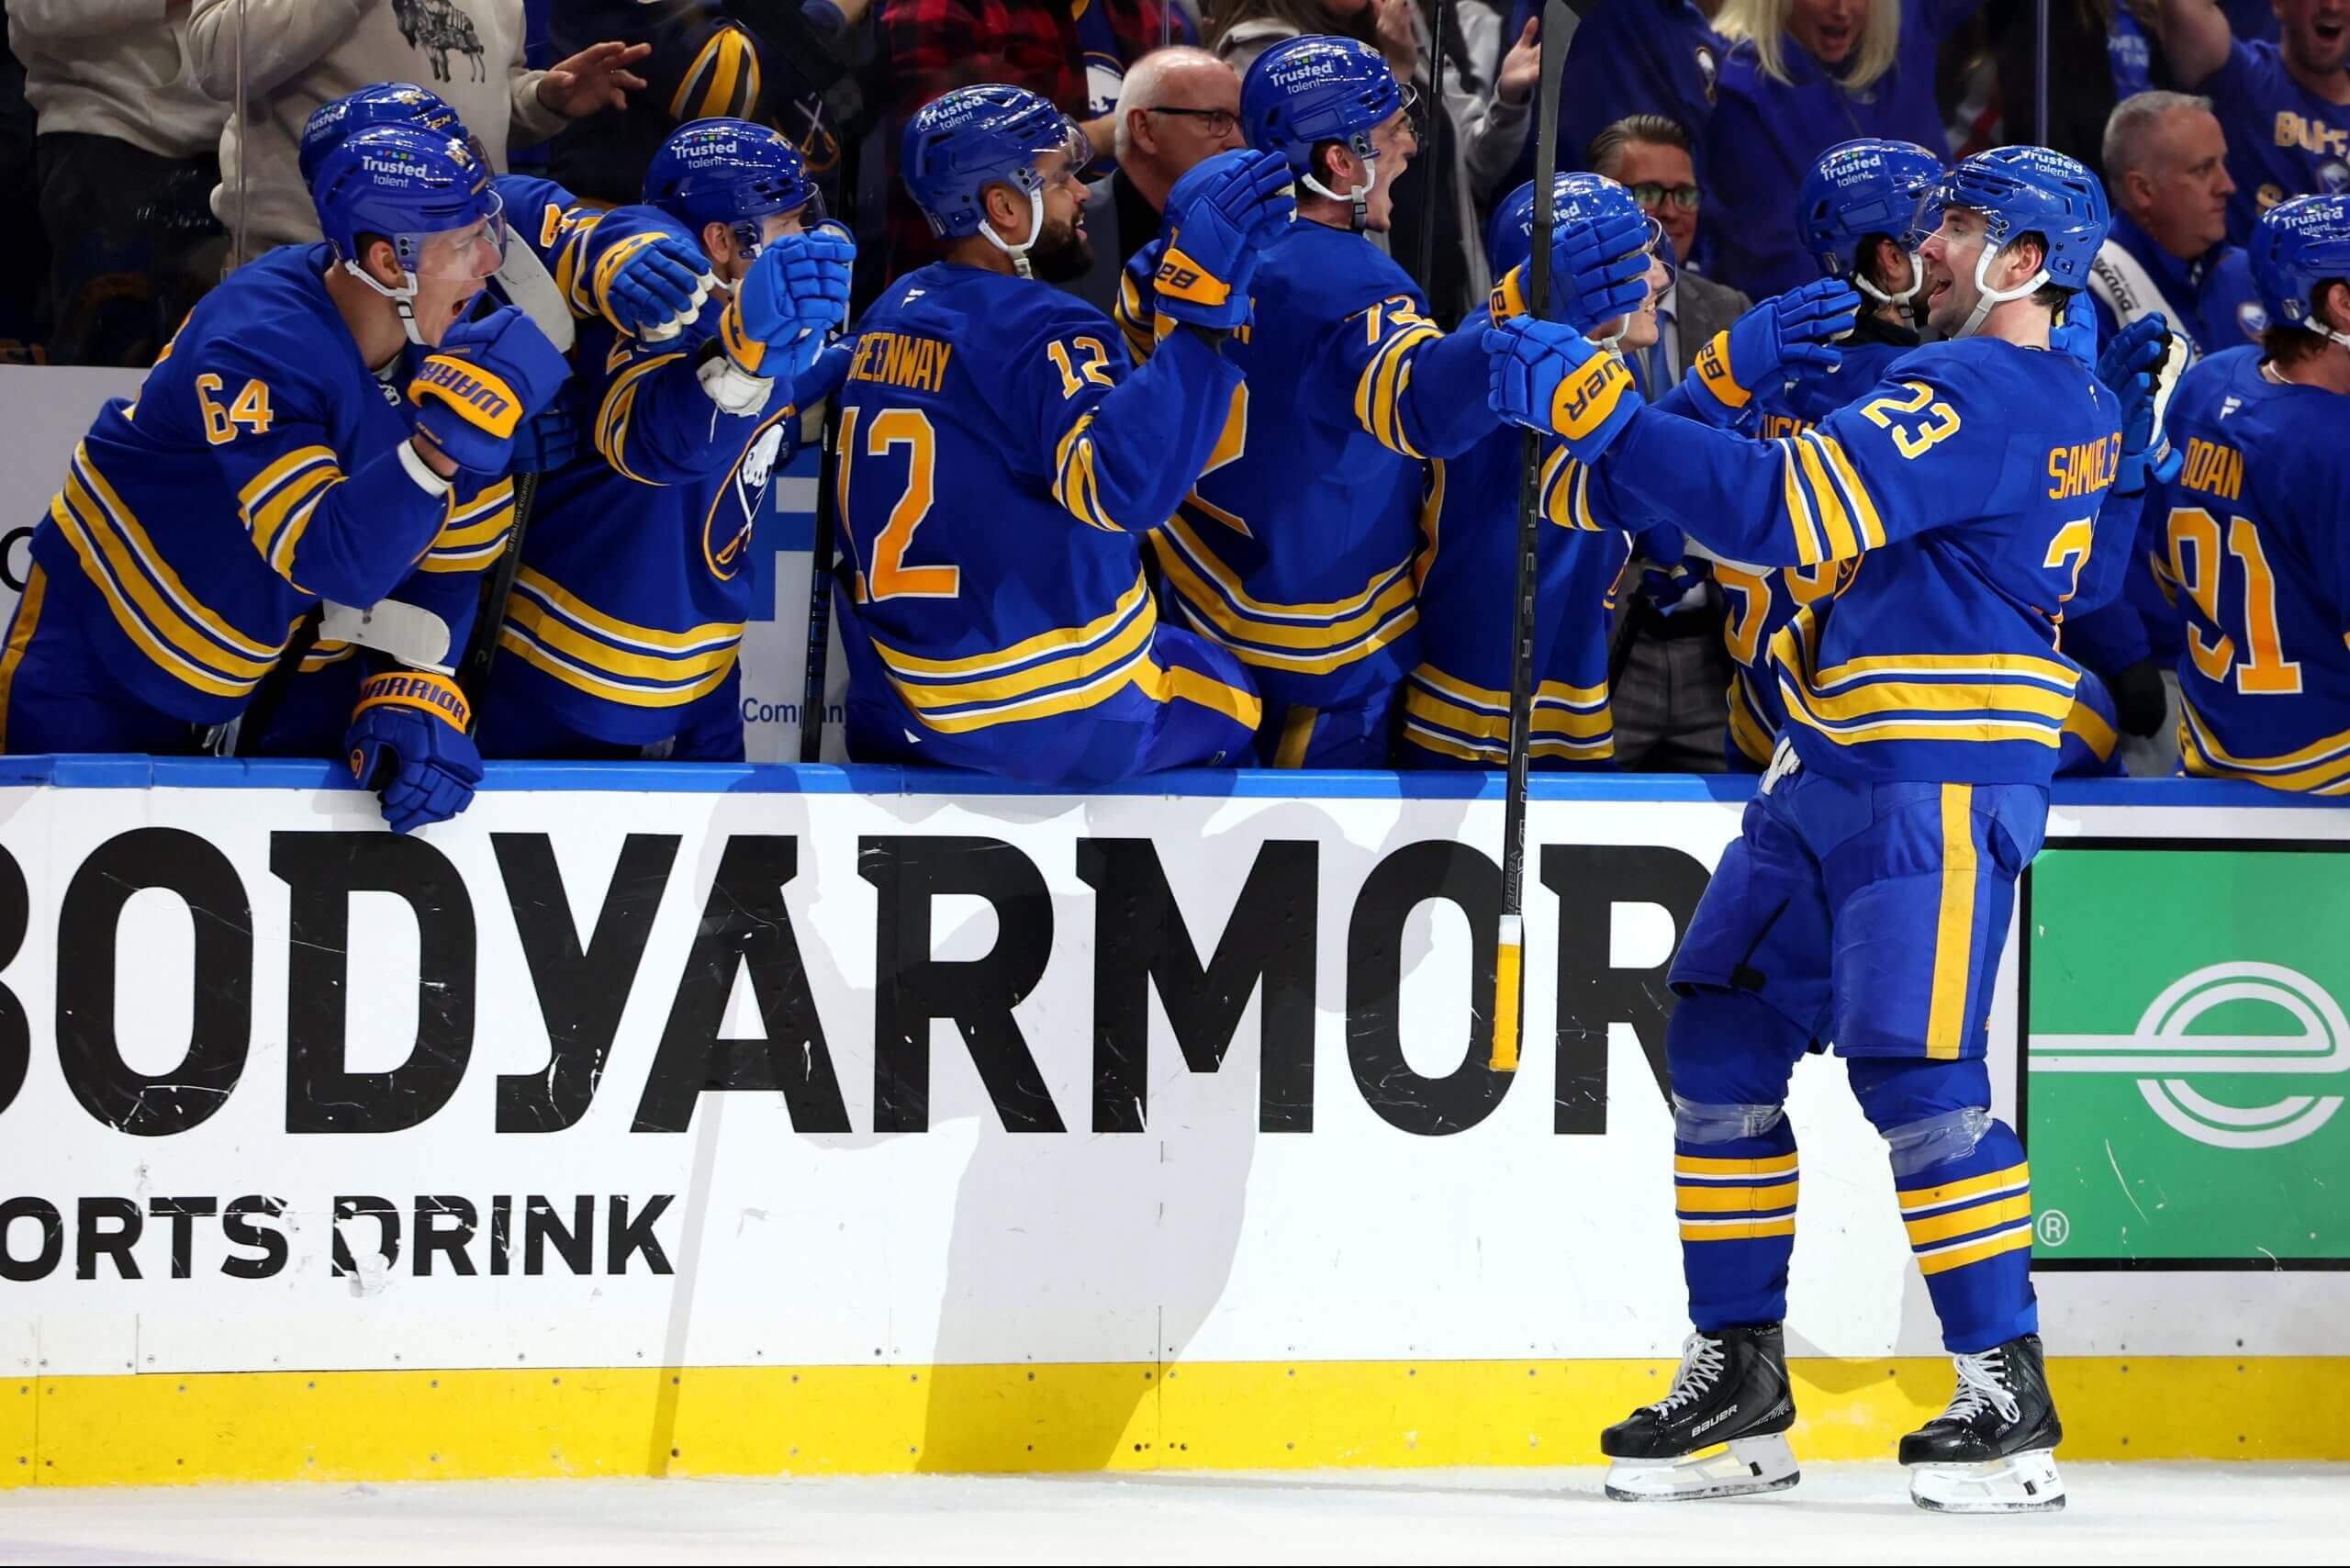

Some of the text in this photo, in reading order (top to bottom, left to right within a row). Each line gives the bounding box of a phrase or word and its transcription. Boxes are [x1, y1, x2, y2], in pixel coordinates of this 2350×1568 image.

[1270, 60, 1334, 87] Trusted
[1286, 77, 1320, 95] talent
[919, 95, 984, 127] Trusted
[939, 111, 974, 130] talent
[673, 140, 737, 160] Trusted
[2275, 111, 2350, 166] BUF
[362, 155, 427, 179] Trusted
[688, 157, 723, 170] talent
[1820, 153, 1881, 182] Trusted
[2021, 149, 2084, 175] Trusted
[2035, 162, 2068, 179] talent
[373, 174, 409, 188] talent
[1837, 170, 1870, 188] talent
[2282, 208, 2344, 230] Trusted
[2298, 223, 2331, 236] talent
[847, 332, 952, 393] REENWAY
[1047, 336, 1117, 400] 12
[419, 361, 510, 420] WARR
[196, 373, 274, 445] 64
[1859, 381, 1962, 460] 23
[2048, 431, 2122, 500] SAMUELS
[2180, 437, 2244, 500] DOAN
[2167, 507, 2303, 695] 91
[0, 824, 1717, 1137] ODYARMOR
[0, 1194, 677, 1282] ORTS DRINK
